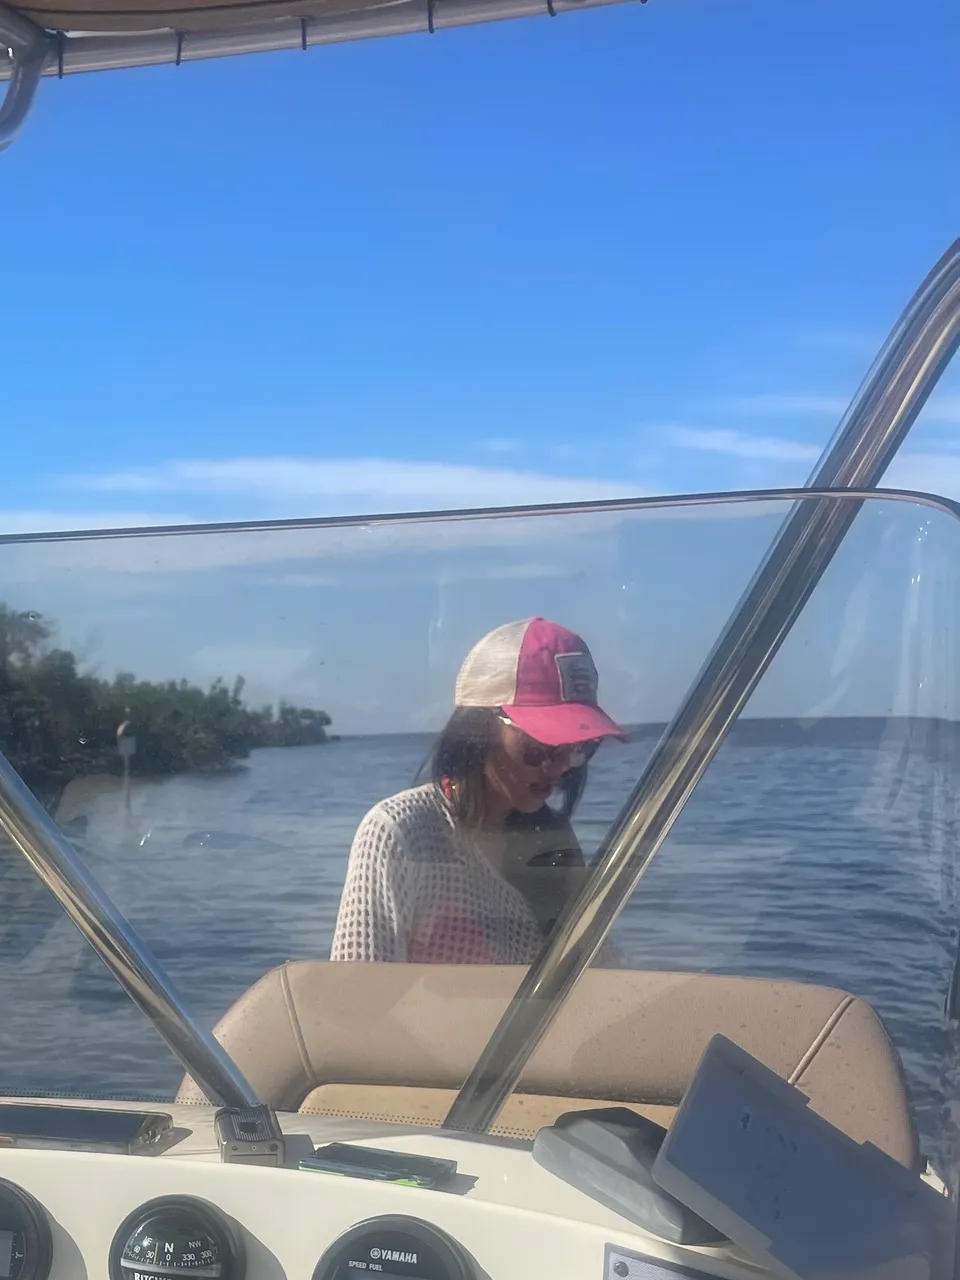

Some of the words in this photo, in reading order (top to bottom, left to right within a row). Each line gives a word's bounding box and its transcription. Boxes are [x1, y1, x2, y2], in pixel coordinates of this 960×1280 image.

[164, 1242, 174, 1253] N
[188, 1240, 201, 1249] NW
[145, 1250, 154, 1259] 30
[182, 1253, 195, 1261] 330
[200, 1250, 212, 1258] 300
[381, 1249, 418, 1264] YAMAHA
[348, 1260, 367, 1269] SPEED
[369, 1263, 383, 1272] FUEL
